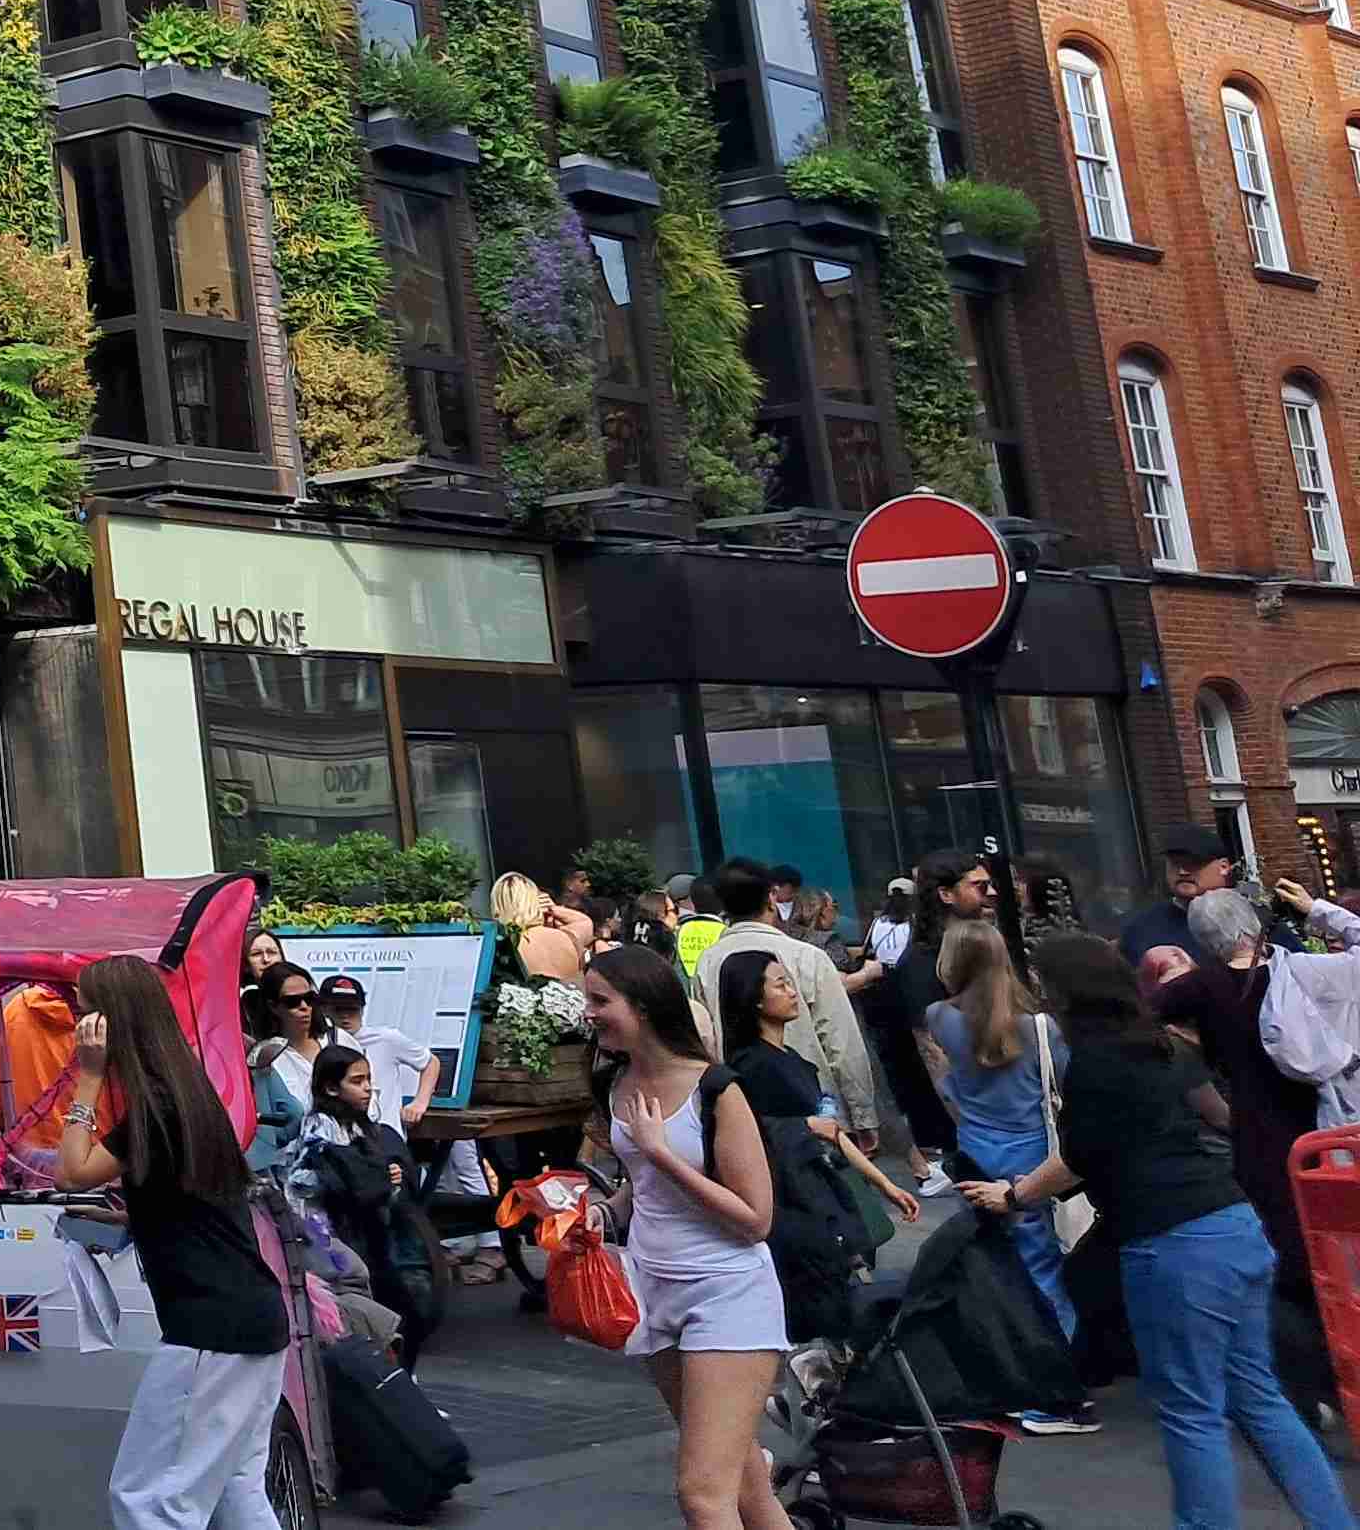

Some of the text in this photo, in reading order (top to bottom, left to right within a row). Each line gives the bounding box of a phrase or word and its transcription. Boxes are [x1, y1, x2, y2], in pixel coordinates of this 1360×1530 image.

[116, 598, 309, 648] REGAL HOUSE
[306, 949, 417, 962] COVENT GARDEN
